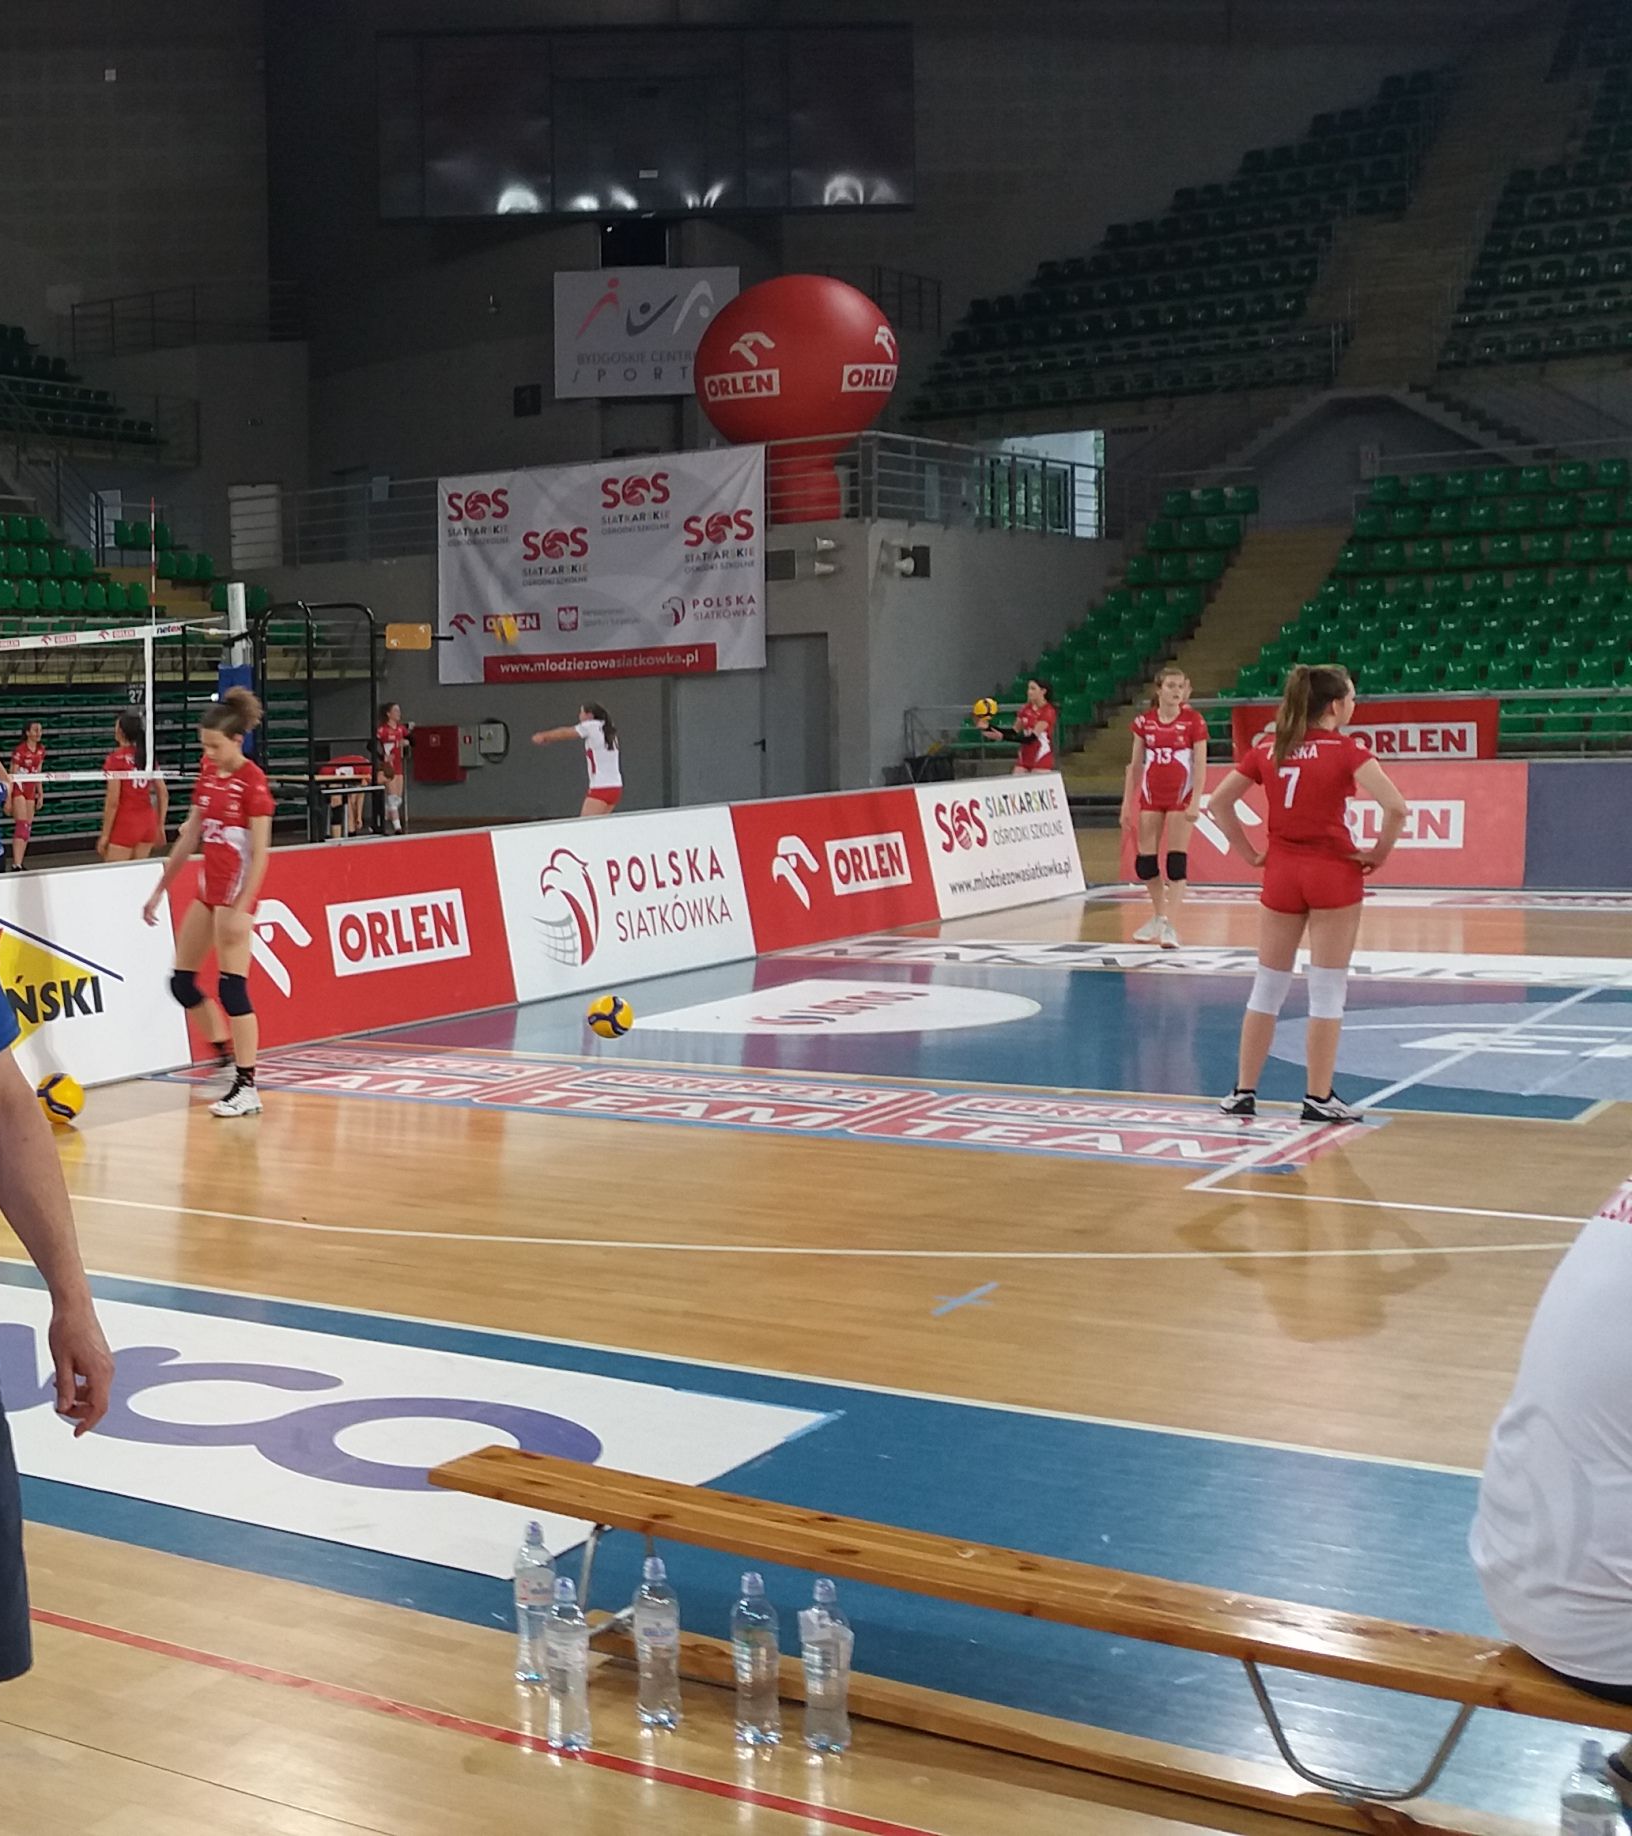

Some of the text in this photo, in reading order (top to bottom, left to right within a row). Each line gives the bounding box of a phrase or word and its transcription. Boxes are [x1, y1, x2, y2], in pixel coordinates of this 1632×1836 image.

[708, 374, 774, 397] ORLEN
[447, 487, 510, 522] SOS
[601, 472, 670, 510] SOS
[522, 526, 589, 562] SOS
[683, 508, 755, 547] SOS
[692, 594, 756, 609] POLSKA
[985, 788, 1059, 819] SIATKARSKIE
[1278, 766, 1301, 809] 7
[935, 798, 988, 853] SOS
[1031, 820, 1065, 840] SZKOLNE
[606, 845, 726, 897] POLSKA
[834, 841, 906, 885] ORLEN
[338, 901, 460, 963] ORLEN
[615, 895, 734, 944] SIATKÓWKA
[518, 1089, 847, 1129] TEAM
[900, 1118, 1282, 1164] TEAM
